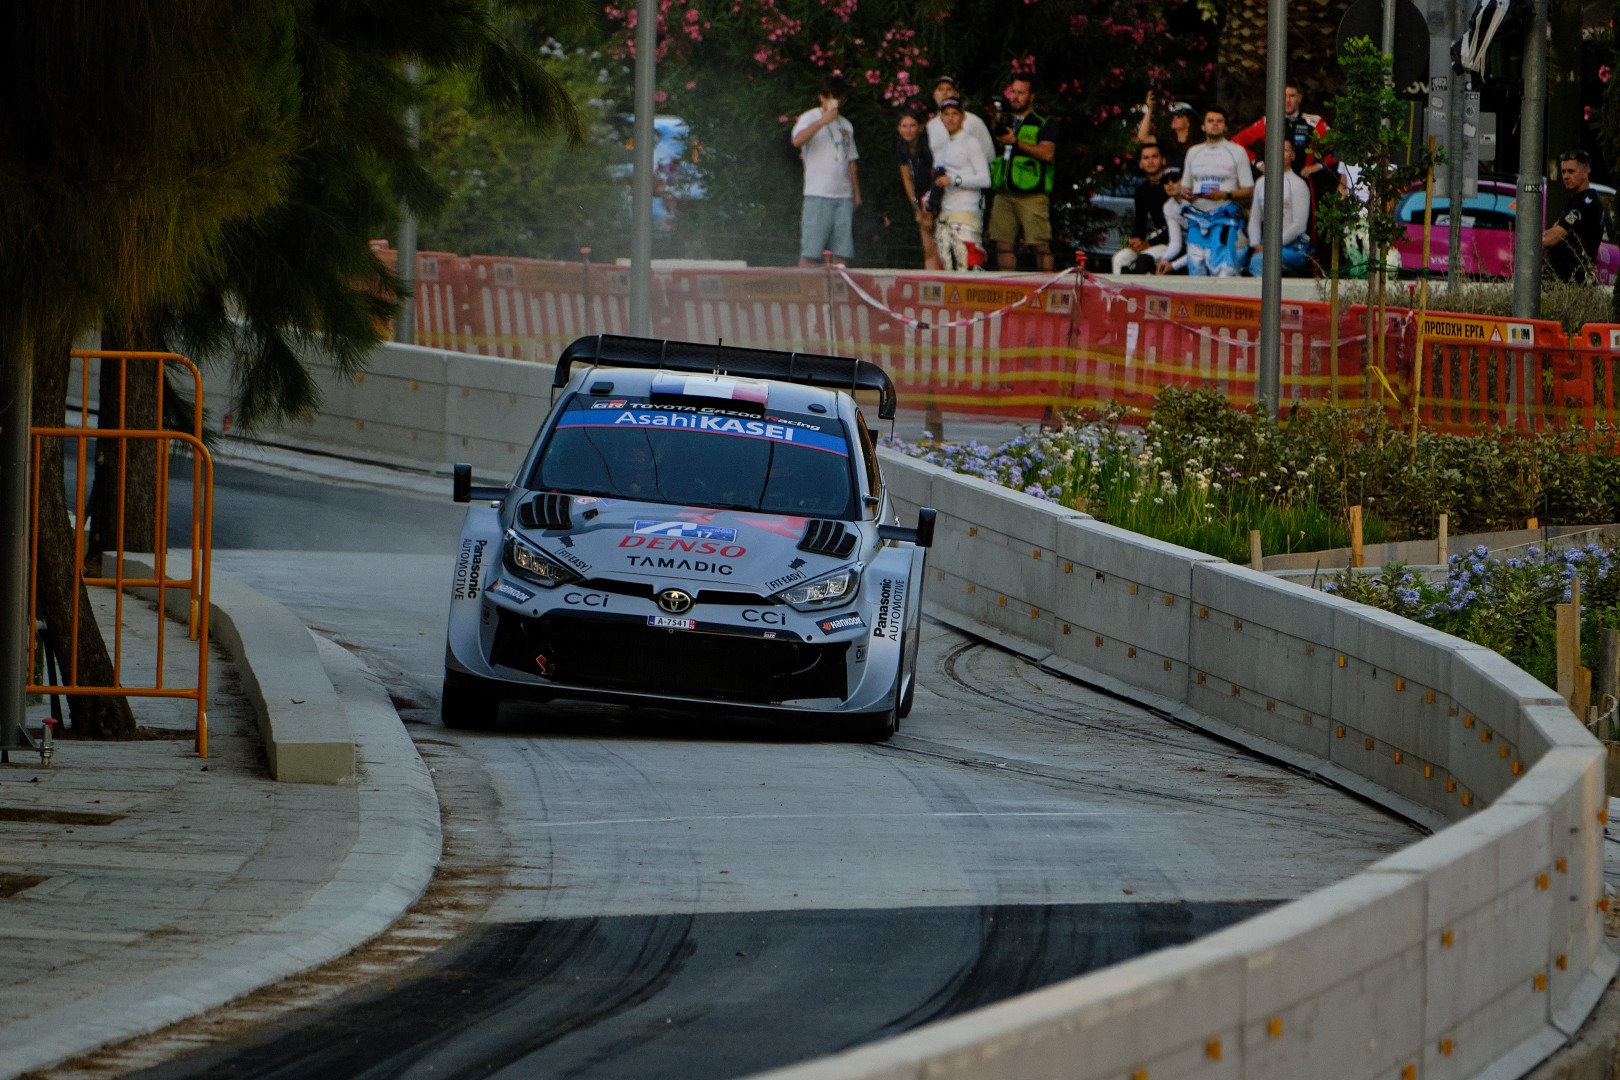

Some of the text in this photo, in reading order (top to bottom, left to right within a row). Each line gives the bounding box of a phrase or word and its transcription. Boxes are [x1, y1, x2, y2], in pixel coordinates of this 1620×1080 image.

[1424, 321, 1485, 339] ΠΡΟΣΟΧΗ ΕΡΓΑ
[630, 402, 697, 412] TOYOTA
[764, 415, 821, 431] Racing
[697, 530, 713, 538] 17
[618, 535, 747, 558] DENSO
[454, 538, 472, 601] AUTOMOTIVE
[467, 539, 488, 599] Panasonic
[627, 555, 733, 575] TAMADIC
[563, 592, 609, 607] CCi
[874, 578, 892, 638] Panasonic
[888, 579, 905, 641] AUTOMOTIVE
[657, 617, 687, 627] A-7541
[742, 609, 786, 625] CCi
